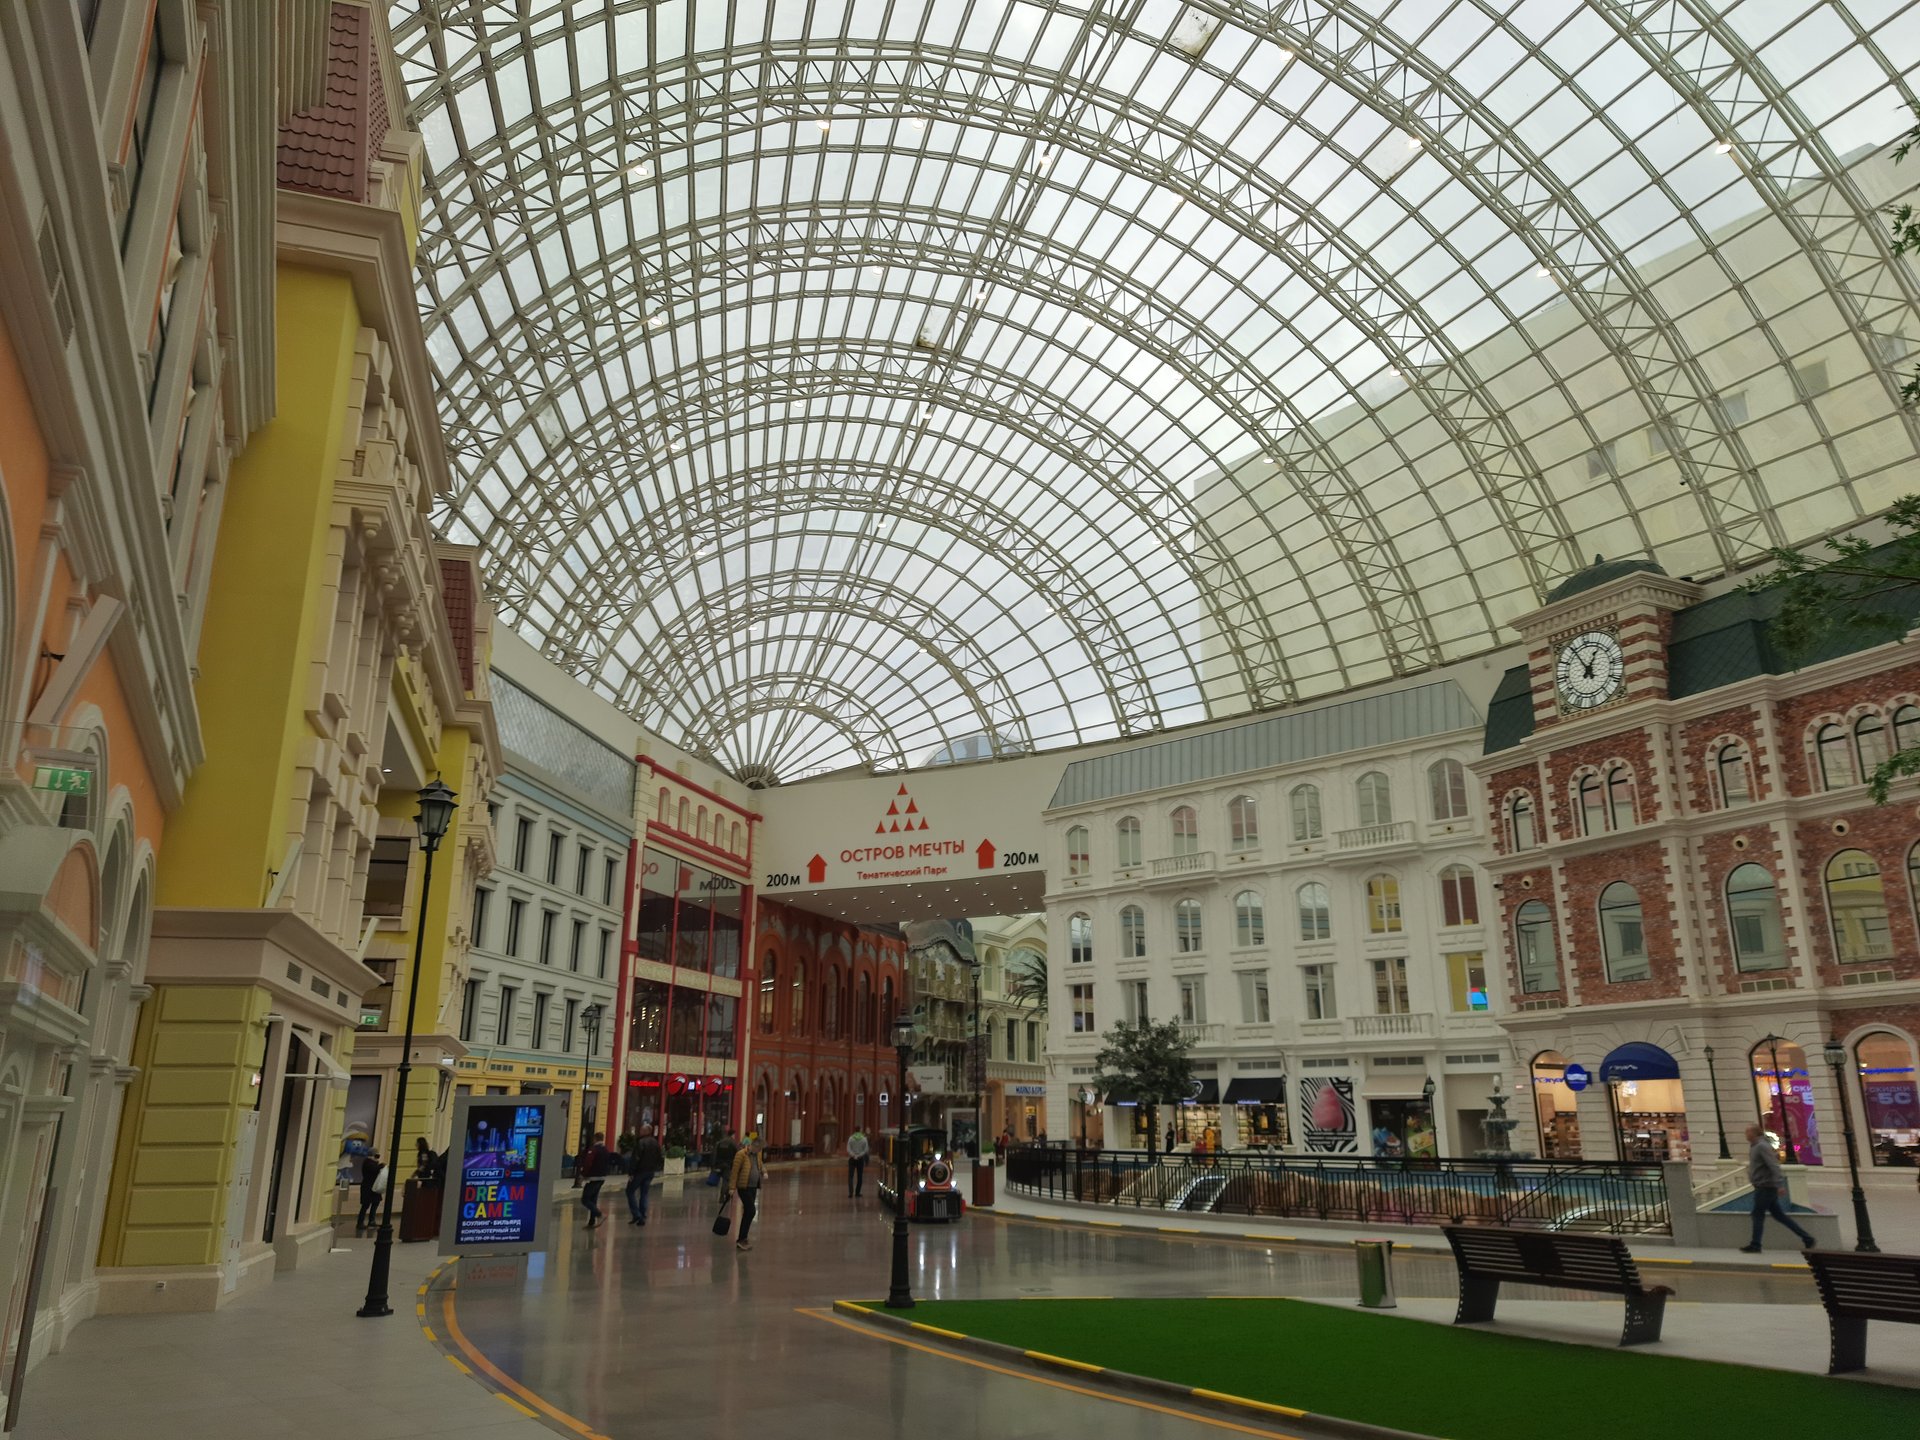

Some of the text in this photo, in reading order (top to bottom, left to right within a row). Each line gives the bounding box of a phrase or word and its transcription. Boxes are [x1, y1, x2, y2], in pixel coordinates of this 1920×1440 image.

[840, 840, 965, 863] ОСТРОВ МЕЧТЫ
[857, 866, 948, 881] Тематический Парк
[470, 1169, 500, 1177] ОТКРЫТ
[464, 1185, 525, 1202] DREAM
[463, 1202, 513, 1218] GAME
[461, 1227, 508, 1235] КОМПЬЮТЕРНЫЙ
